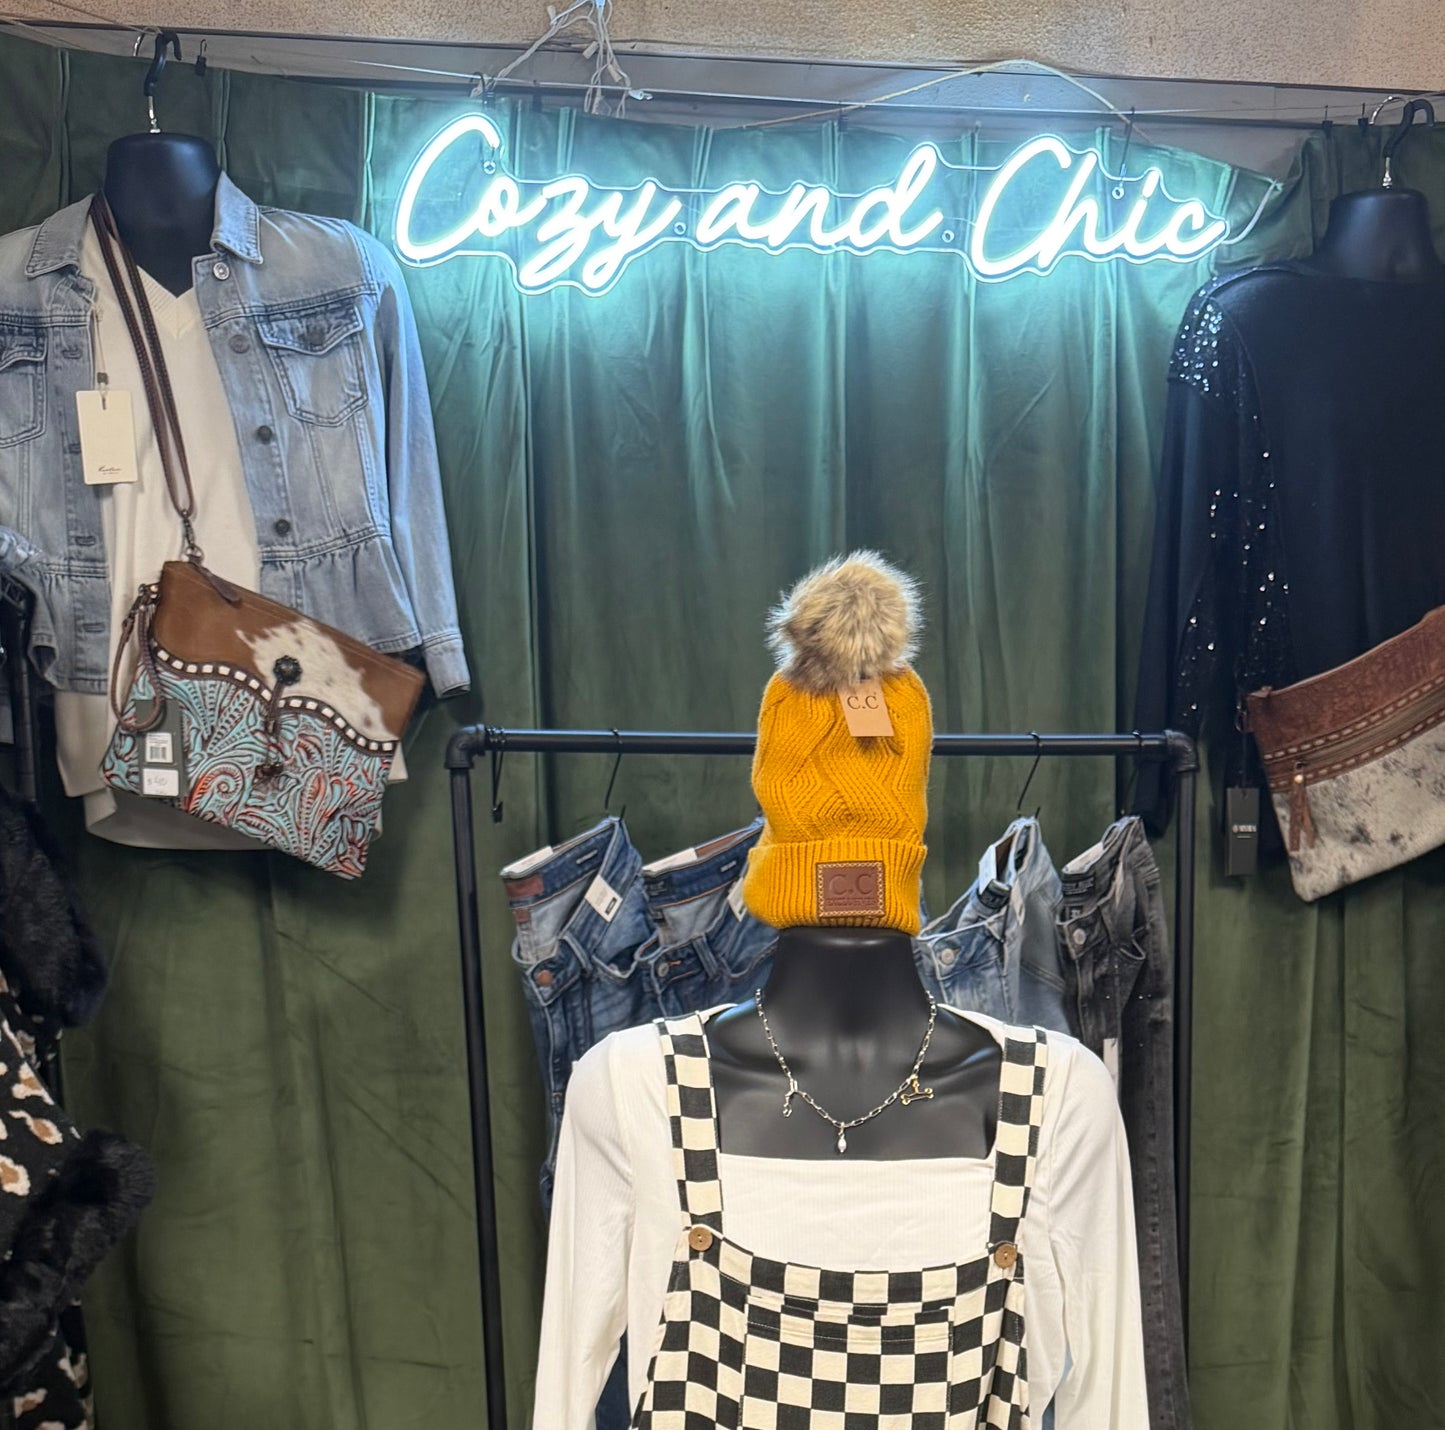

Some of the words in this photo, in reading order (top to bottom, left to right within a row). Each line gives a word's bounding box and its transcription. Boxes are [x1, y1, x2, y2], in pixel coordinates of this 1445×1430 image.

[396, 115, 682, 288] Cozy
[696, 144, 944, 248] and
[970, 136, 1226, 276] Chic
[846, 694, 879, 710] C.C
[828, 873, 875, 894] C.C
